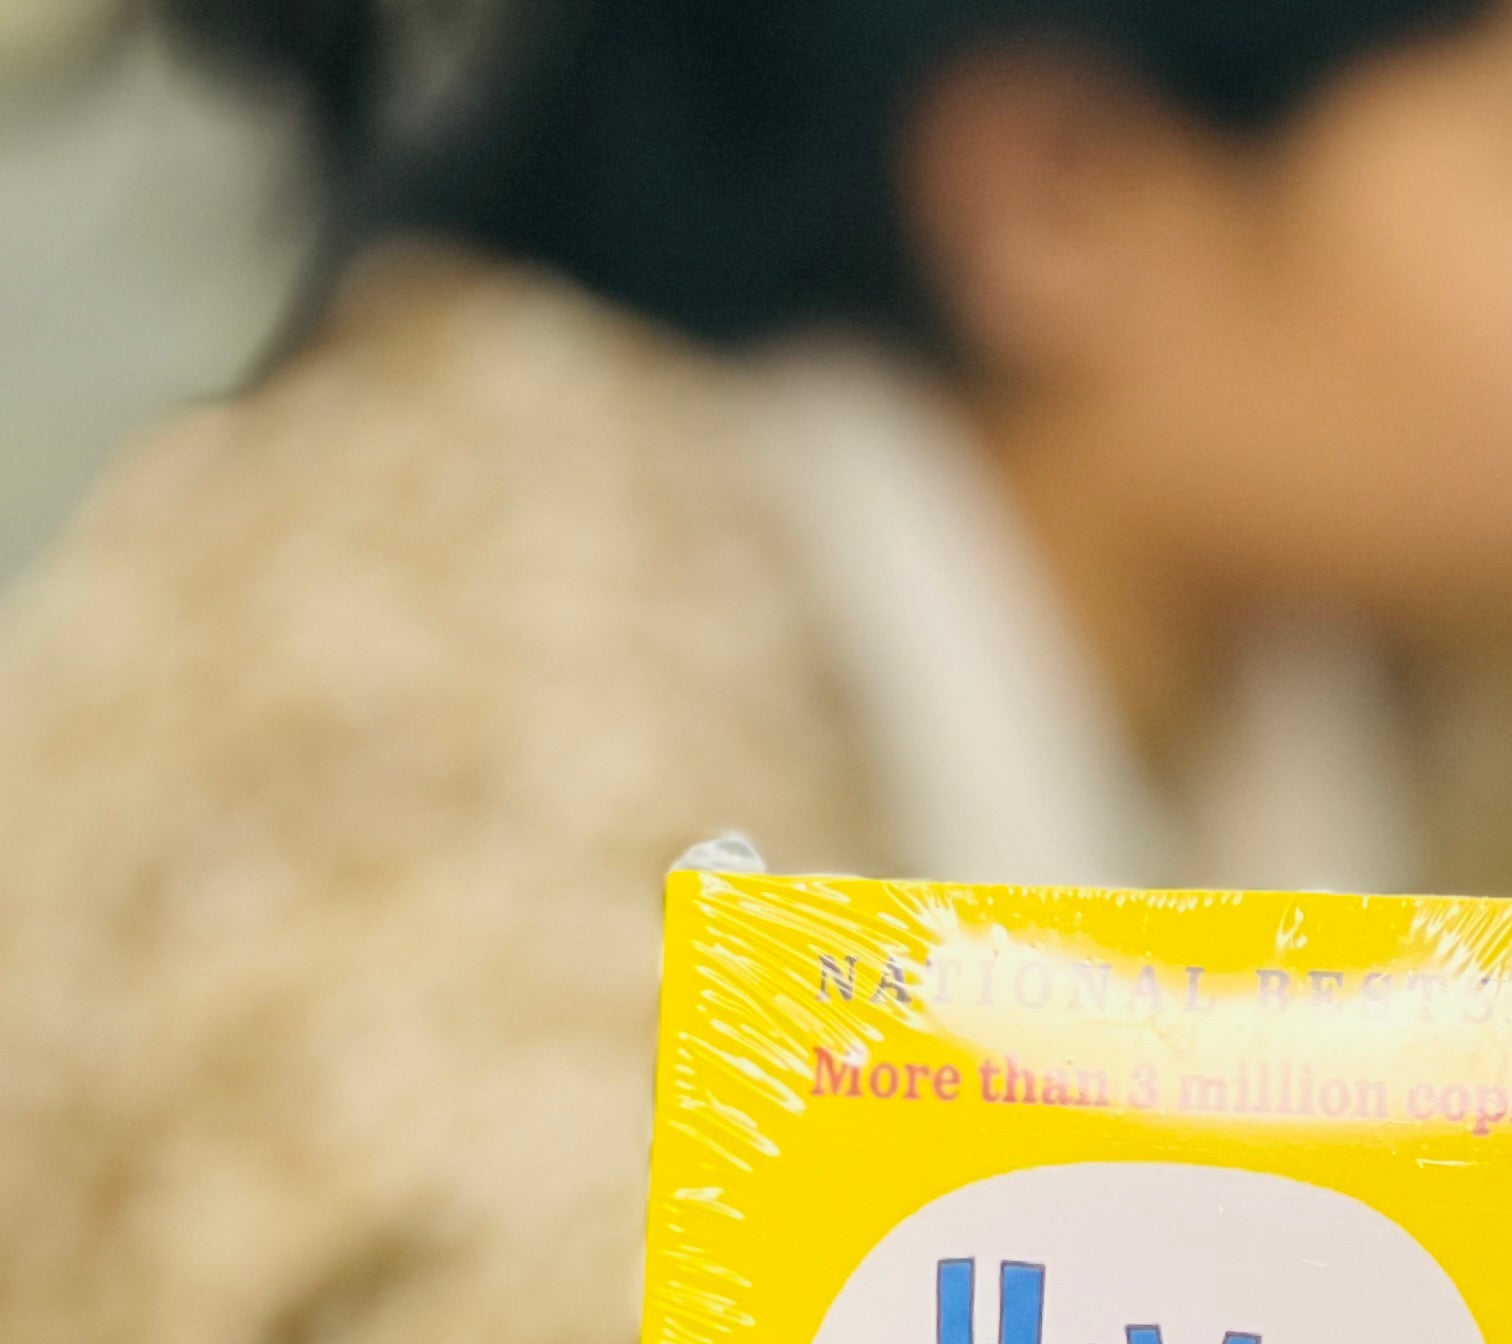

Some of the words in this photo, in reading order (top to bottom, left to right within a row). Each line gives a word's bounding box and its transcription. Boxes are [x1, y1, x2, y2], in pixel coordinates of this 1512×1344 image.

[816, 954, 1216, 1014] NATIONAL
[811, 1046, 961, 1101] More
[978, 1056, 1111, 1108] than
[1130, 1062, 1161, 1110] 3
[1178, 1056, 1388, 1122] million
